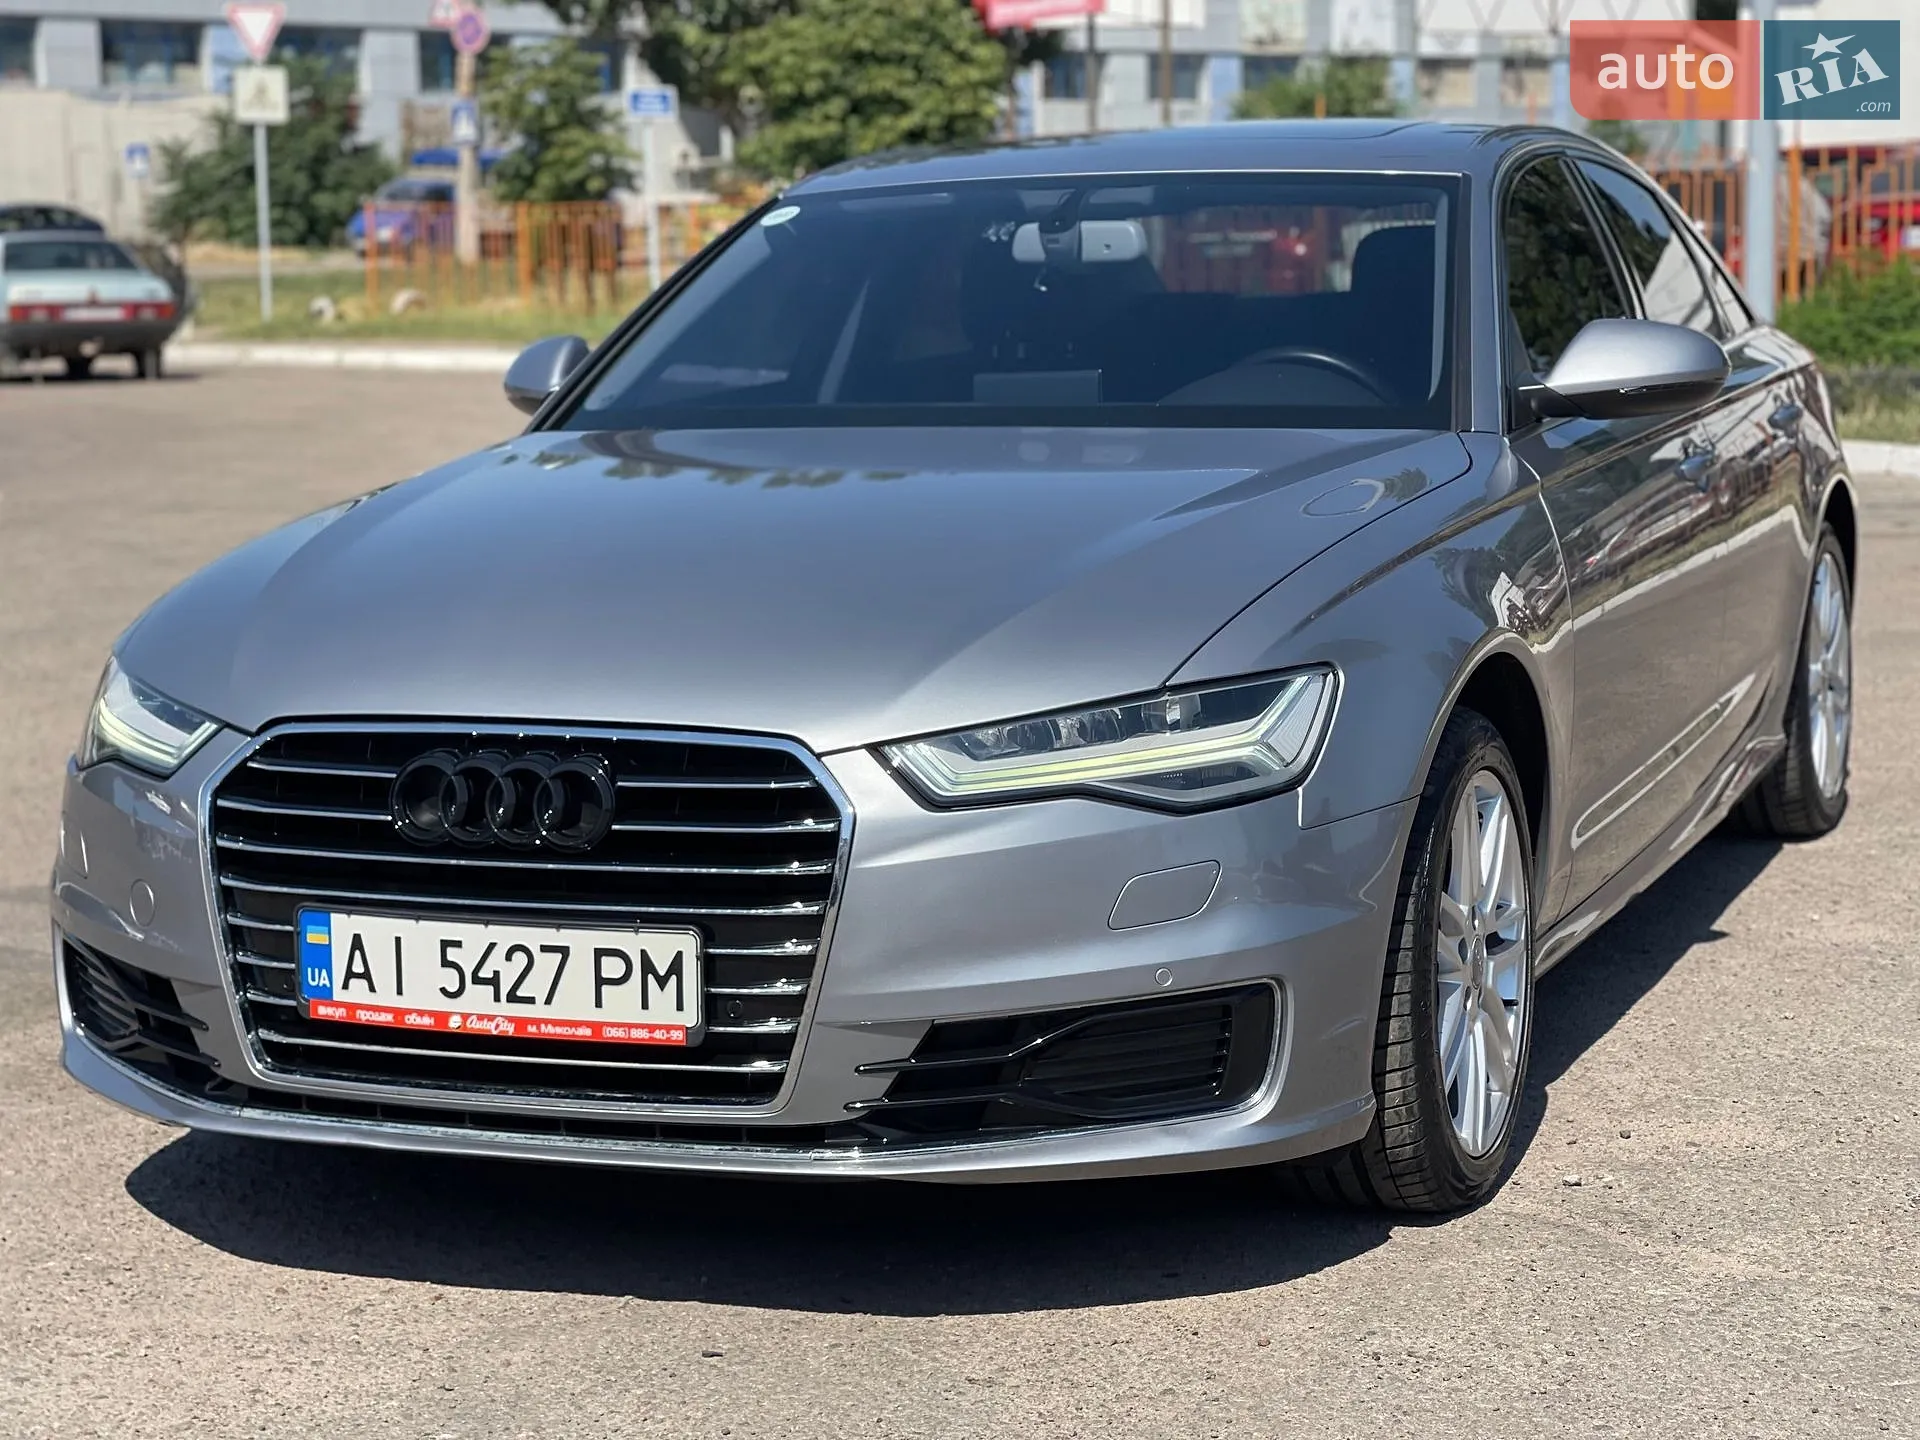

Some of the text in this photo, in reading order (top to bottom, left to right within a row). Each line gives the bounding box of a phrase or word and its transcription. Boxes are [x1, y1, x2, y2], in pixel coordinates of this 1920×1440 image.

[307, 967, 331, 988] UA
[341, 932, 685, 1012] AI 5427 PM
[355, 1009, 395, 1023] продаж
[404, 1012, 435, 1026] обмін
[540, 1023, 593, 1037] Миколаїв
[602, 1025, 629, 1039] (066)
[630, 1028, 683, 1041] 886-40-99
